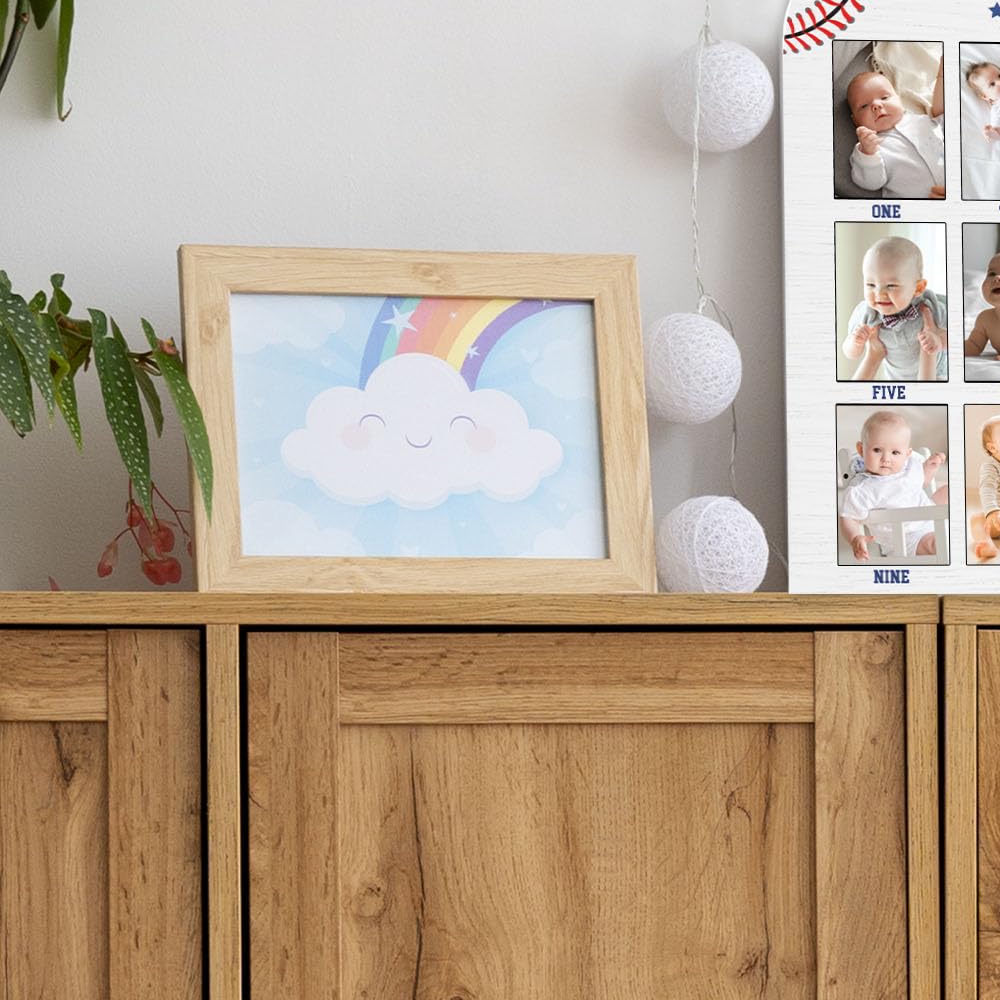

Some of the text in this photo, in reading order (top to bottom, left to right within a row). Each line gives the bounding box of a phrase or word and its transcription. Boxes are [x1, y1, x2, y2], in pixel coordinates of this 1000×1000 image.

[872, 204, 901, 219] ONE
[872, 385, 905, 400] FIVE
[873, 569, 909, 584] NINE
